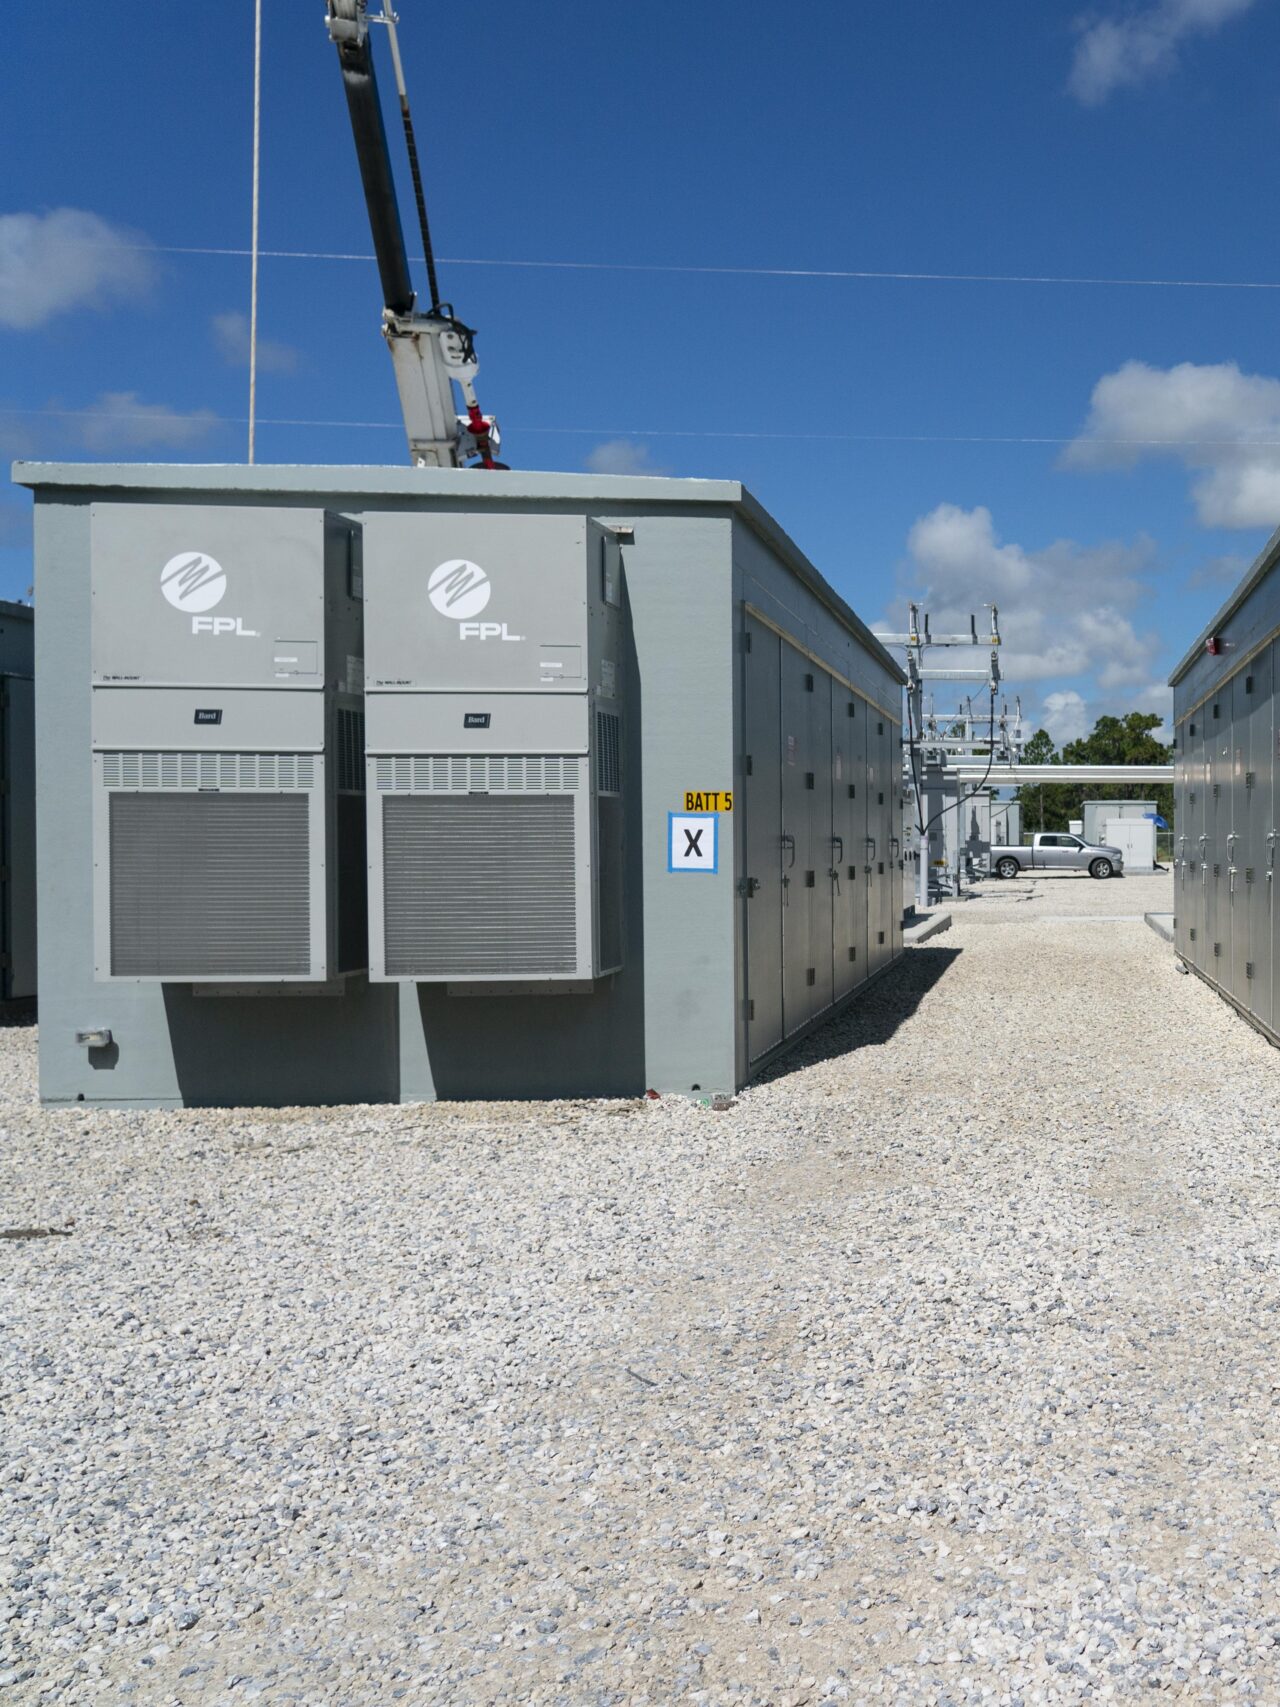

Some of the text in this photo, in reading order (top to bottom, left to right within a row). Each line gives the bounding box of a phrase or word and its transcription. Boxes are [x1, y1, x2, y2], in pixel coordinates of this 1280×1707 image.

[192, 616, 256, 636] FPL
[459, 623, 520, 641] FPL
[686, 792, 733, 811] BATT 5
[684, 829, 703, 857] X
